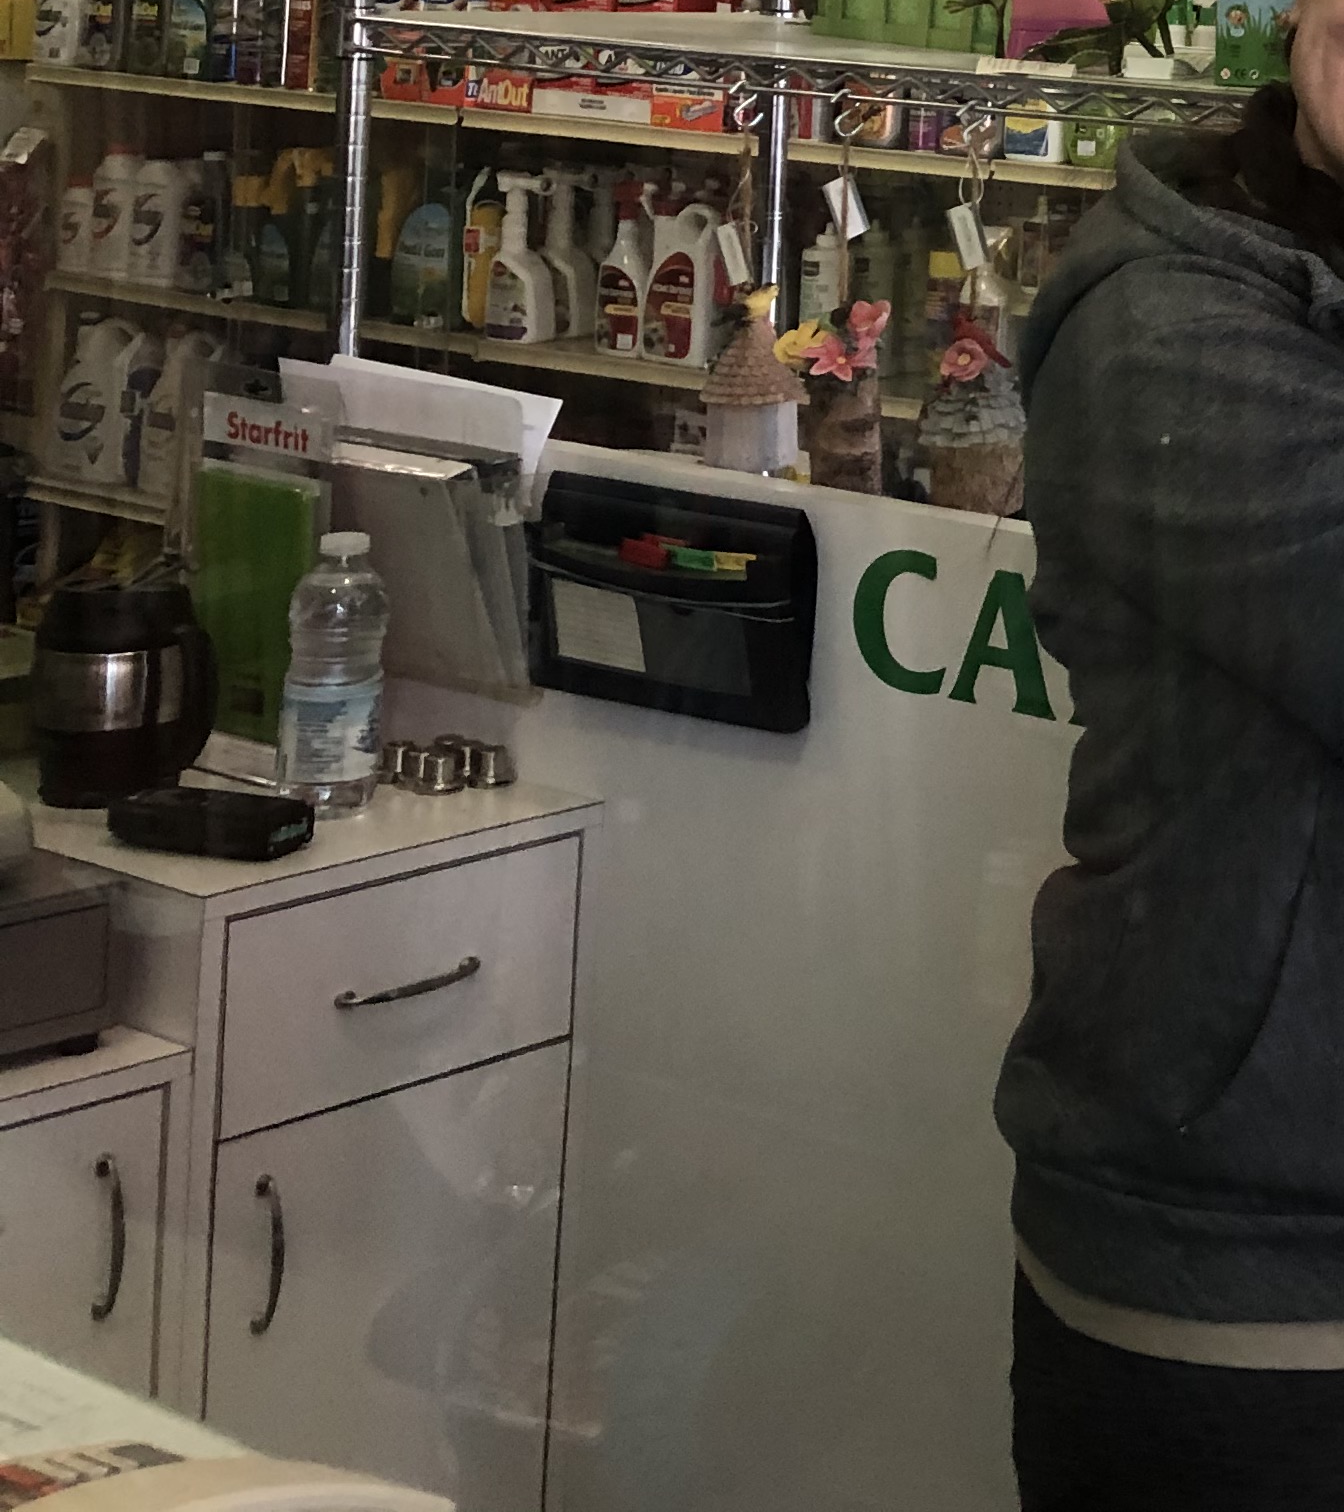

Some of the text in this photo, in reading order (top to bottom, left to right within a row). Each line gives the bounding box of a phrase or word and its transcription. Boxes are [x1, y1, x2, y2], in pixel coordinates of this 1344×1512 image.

[478, 76, 530, 110] AntOut
[226, 410, 309, 454] Starfrit
[853, 549, 1060, 723] CA
